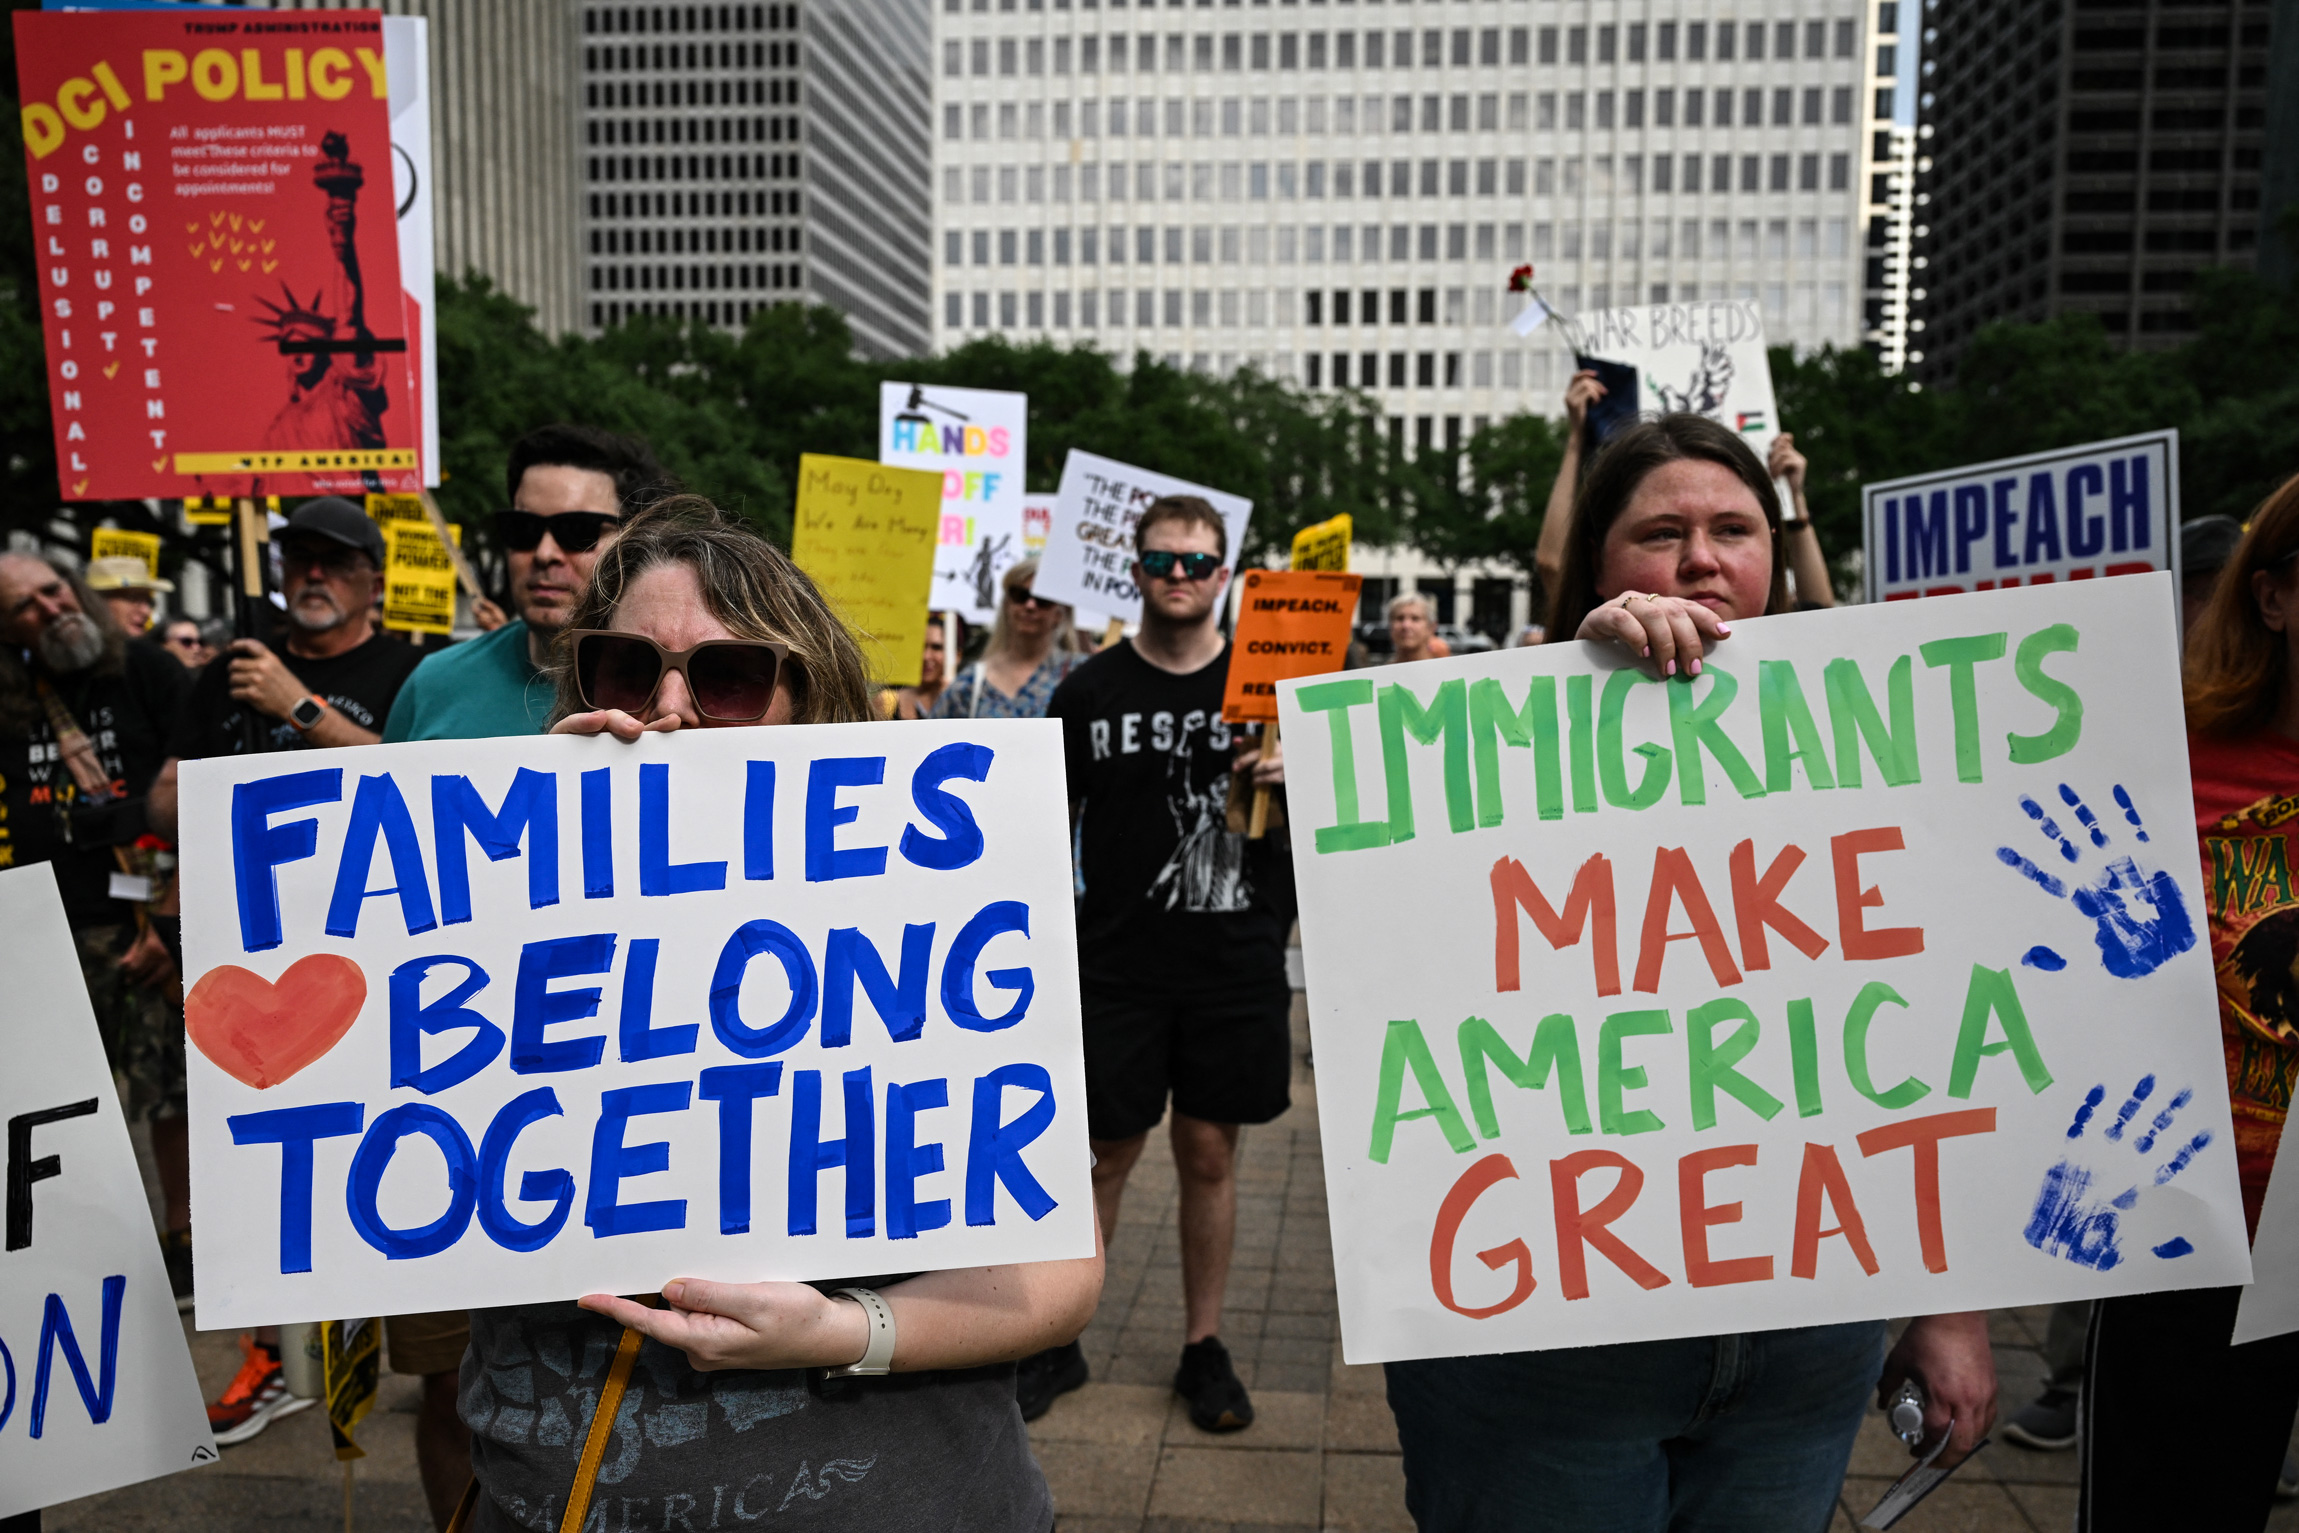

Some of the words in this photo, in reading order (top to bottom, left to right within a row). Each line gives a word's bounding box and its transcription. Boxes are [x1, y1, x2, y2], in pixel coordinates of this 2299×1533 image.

[142, 46, 388, 101] POLICY
[169, 125, 189, 139] All
[193, 124, 265, 141] applicants
[267, 125, 305, 139] MUST
[172, 162, 190, 176] be
[192, 161, 269, 176] considered
[270, 161, 292, 176] for
[250, 143, 301, 158] criteria
[302, 144, 319, 158] to
[1649, 299, 1763, 350] BREEDS
[892, 418, 1011, 459] HANDS
[1884, 455, 2151, 584] IMPEACH
[1247, 640, 1333, 655] CONVICT.
[1253, 598, 1343, 613] IMPEACH.
[1296, 624, 2084, 855] IMMIGRANTS
[231, 742, 995, 953] FAMILIES
[1490, 826, 1926, 998] MAKE
[388, 900, 1035, 1096] BELONG
[1368, 963, 2054, 1164] AMERICA
[226, 1060, 1059, 1275] TOGETHER
[1429, 1106, 1997, 1320] GREAT
